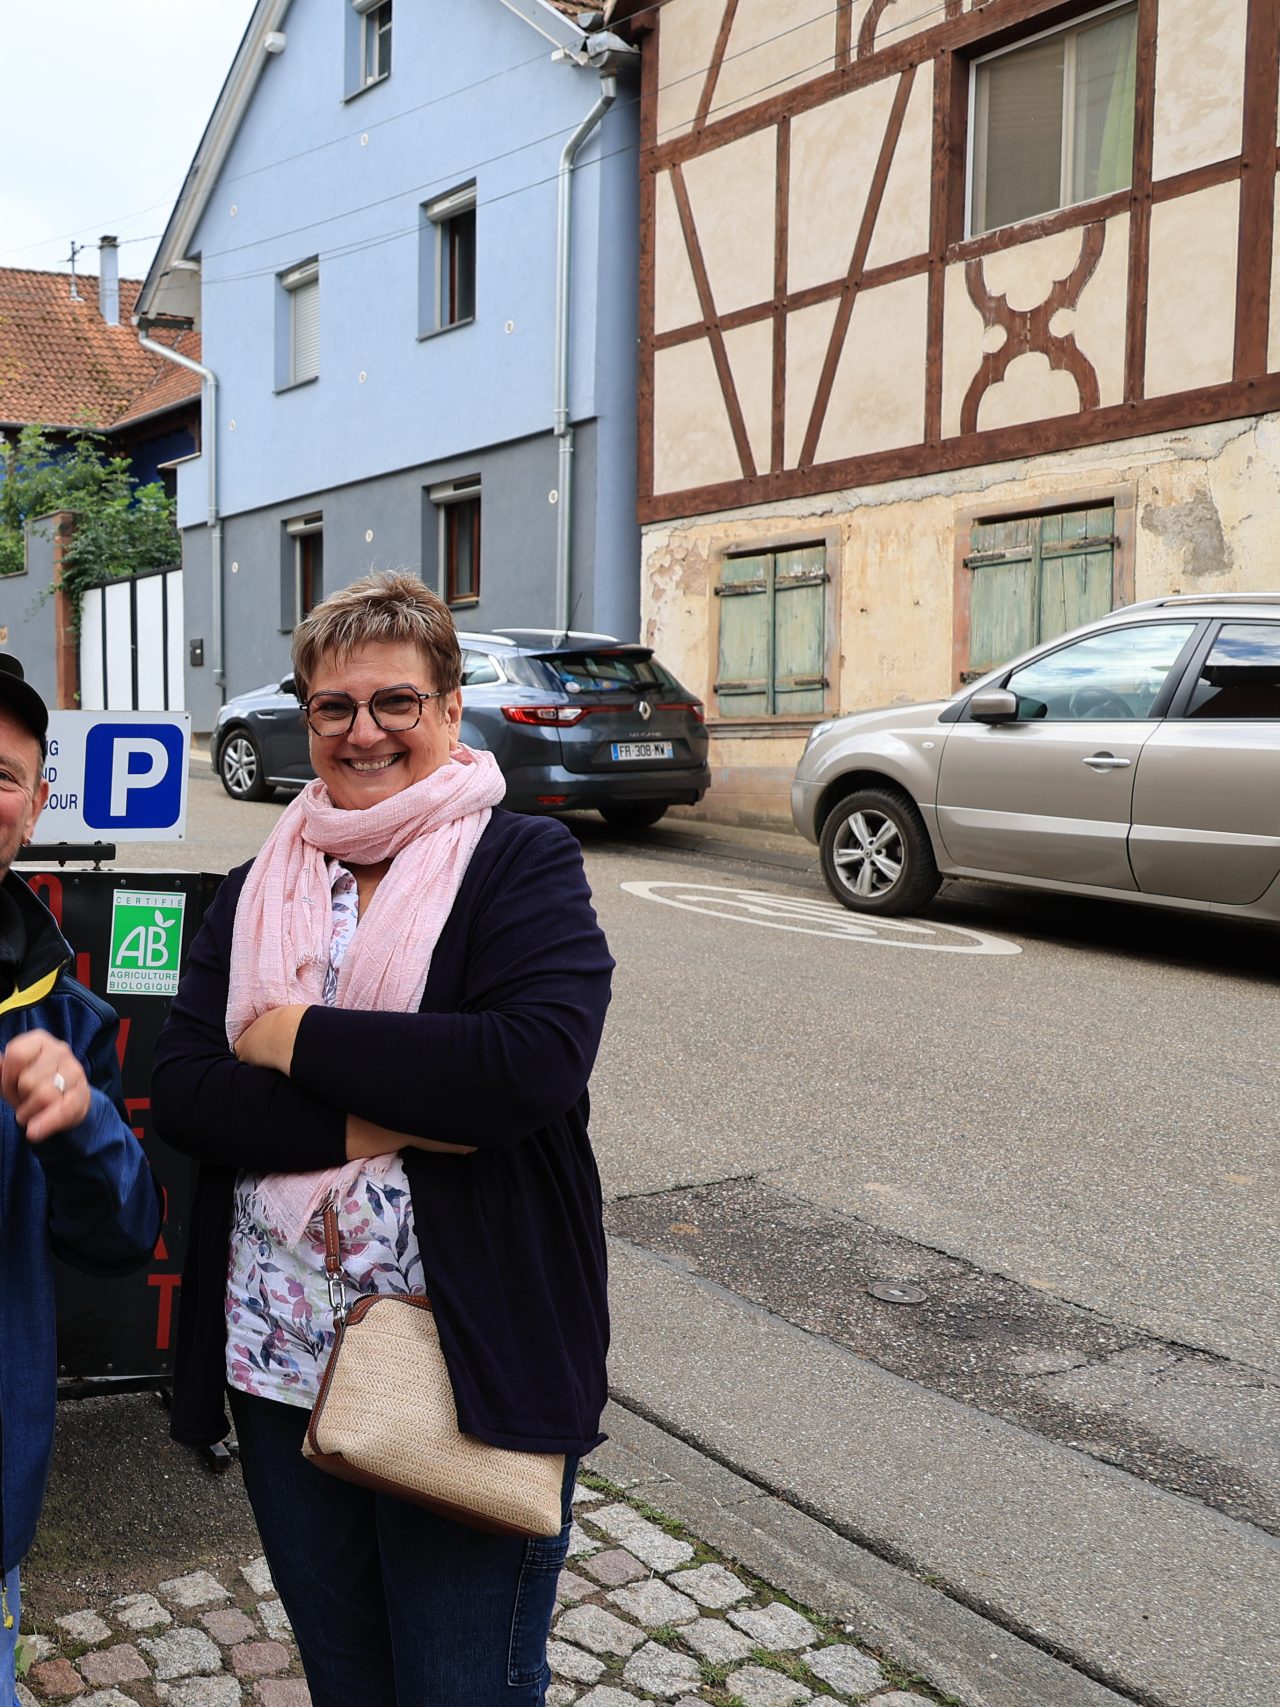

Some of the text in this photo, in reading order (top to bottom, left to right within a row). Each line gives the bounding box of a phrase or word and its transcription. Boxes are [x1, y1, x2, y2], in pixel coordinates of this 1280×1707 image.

[110, 738, 169, 817] P
[42, 793, 78, 810] OUR
[115, 925, 169, 967] AB
[110, 970, 178, 981] AGRICULTURE
[109, 981, 177, 991] BIOLOGIQUE
